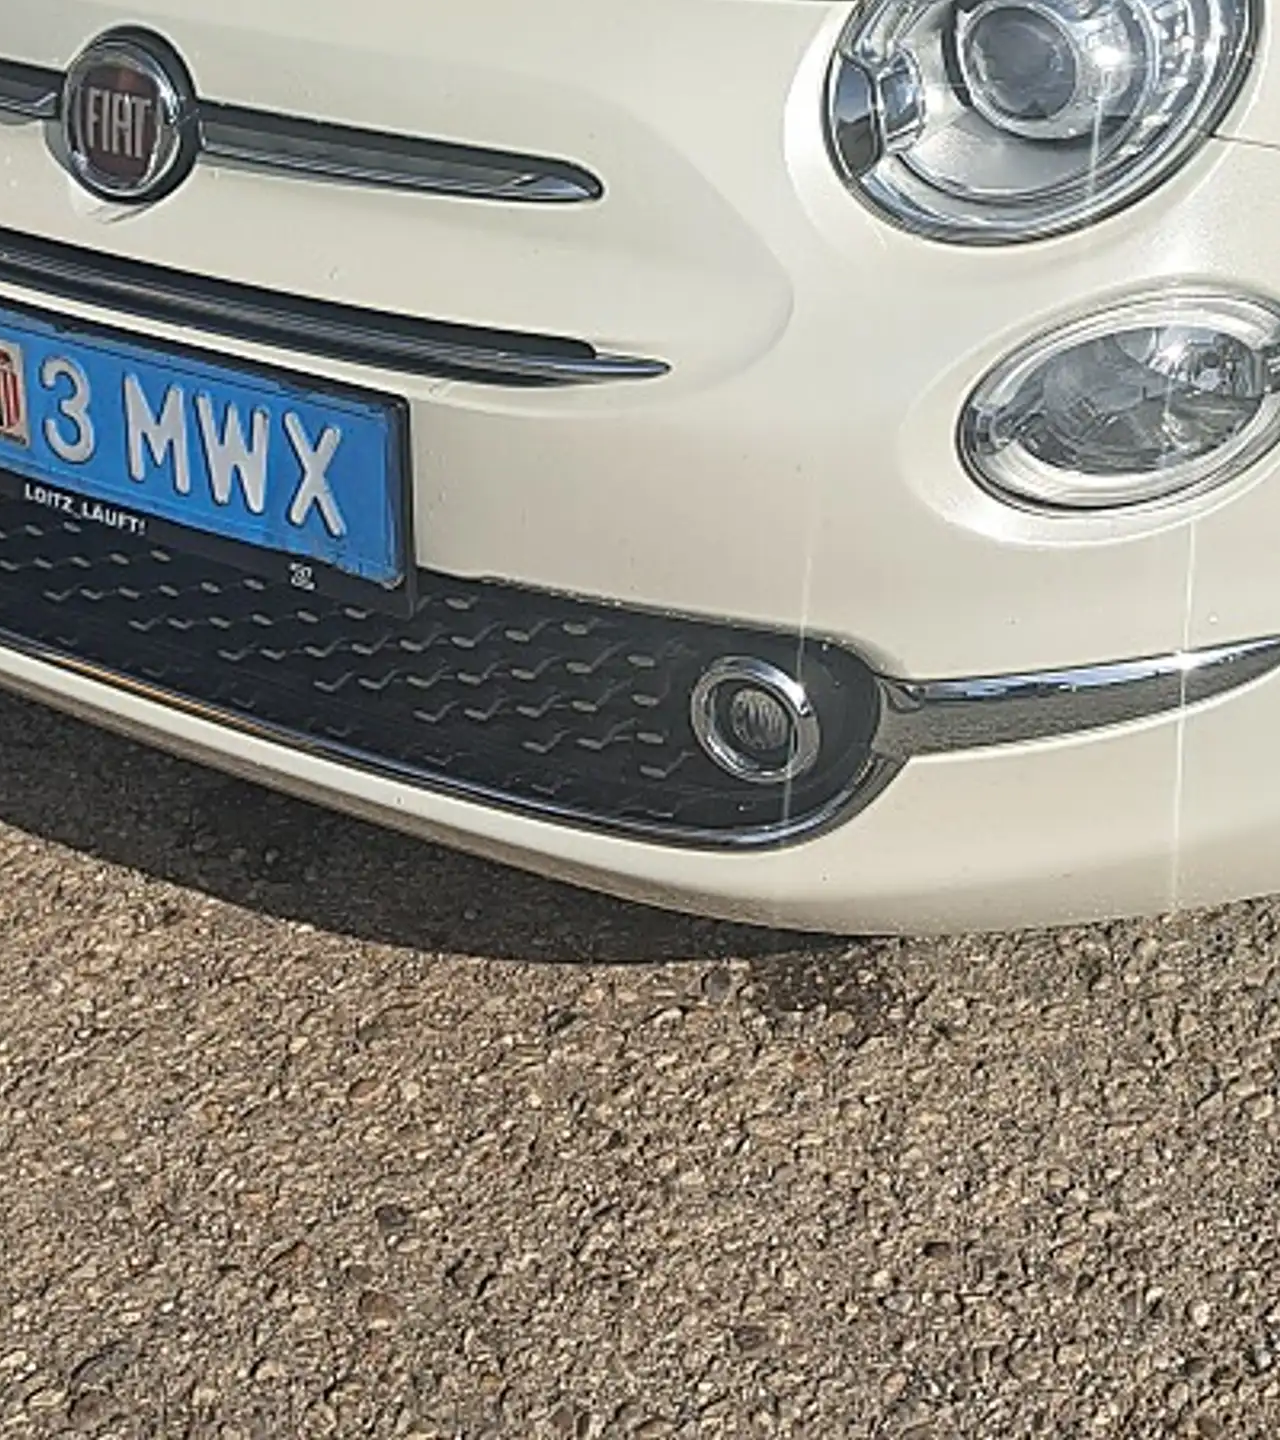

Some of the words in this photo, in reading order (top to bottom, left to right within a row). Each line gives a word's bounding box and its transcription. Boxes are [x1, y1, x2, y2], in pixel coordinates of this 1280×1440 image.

[86, 85, 153, 158] FIAT
[41, 355, 97, 464] 3
[124, 371, 348, 539] MWX
